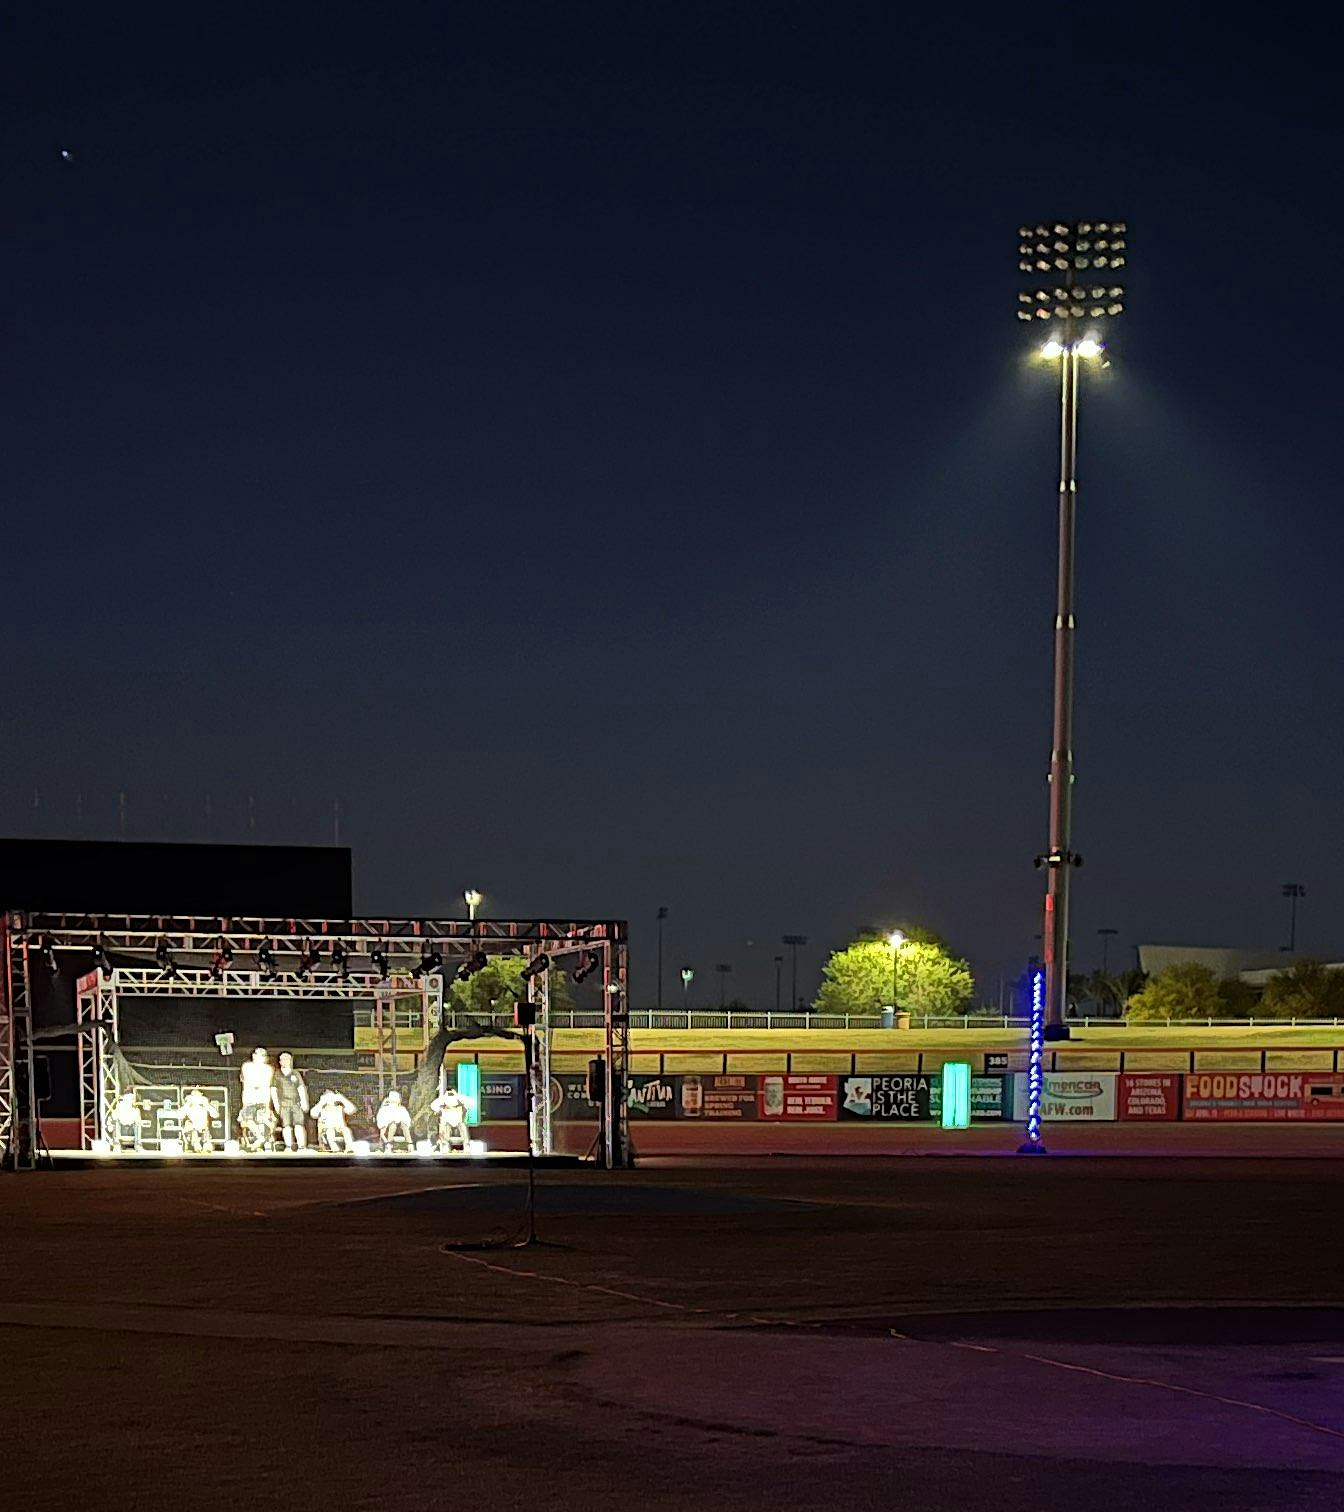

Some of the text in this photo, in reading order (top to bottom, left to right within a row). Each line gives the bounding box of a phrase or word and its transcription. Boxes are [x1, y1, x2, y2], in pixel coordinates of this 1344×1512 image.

[872, 1077, 928, 1091] PEORIA
[872, 1091, 917, 1104] IS THE
[872, 1103, 920, 1117] PLACE
